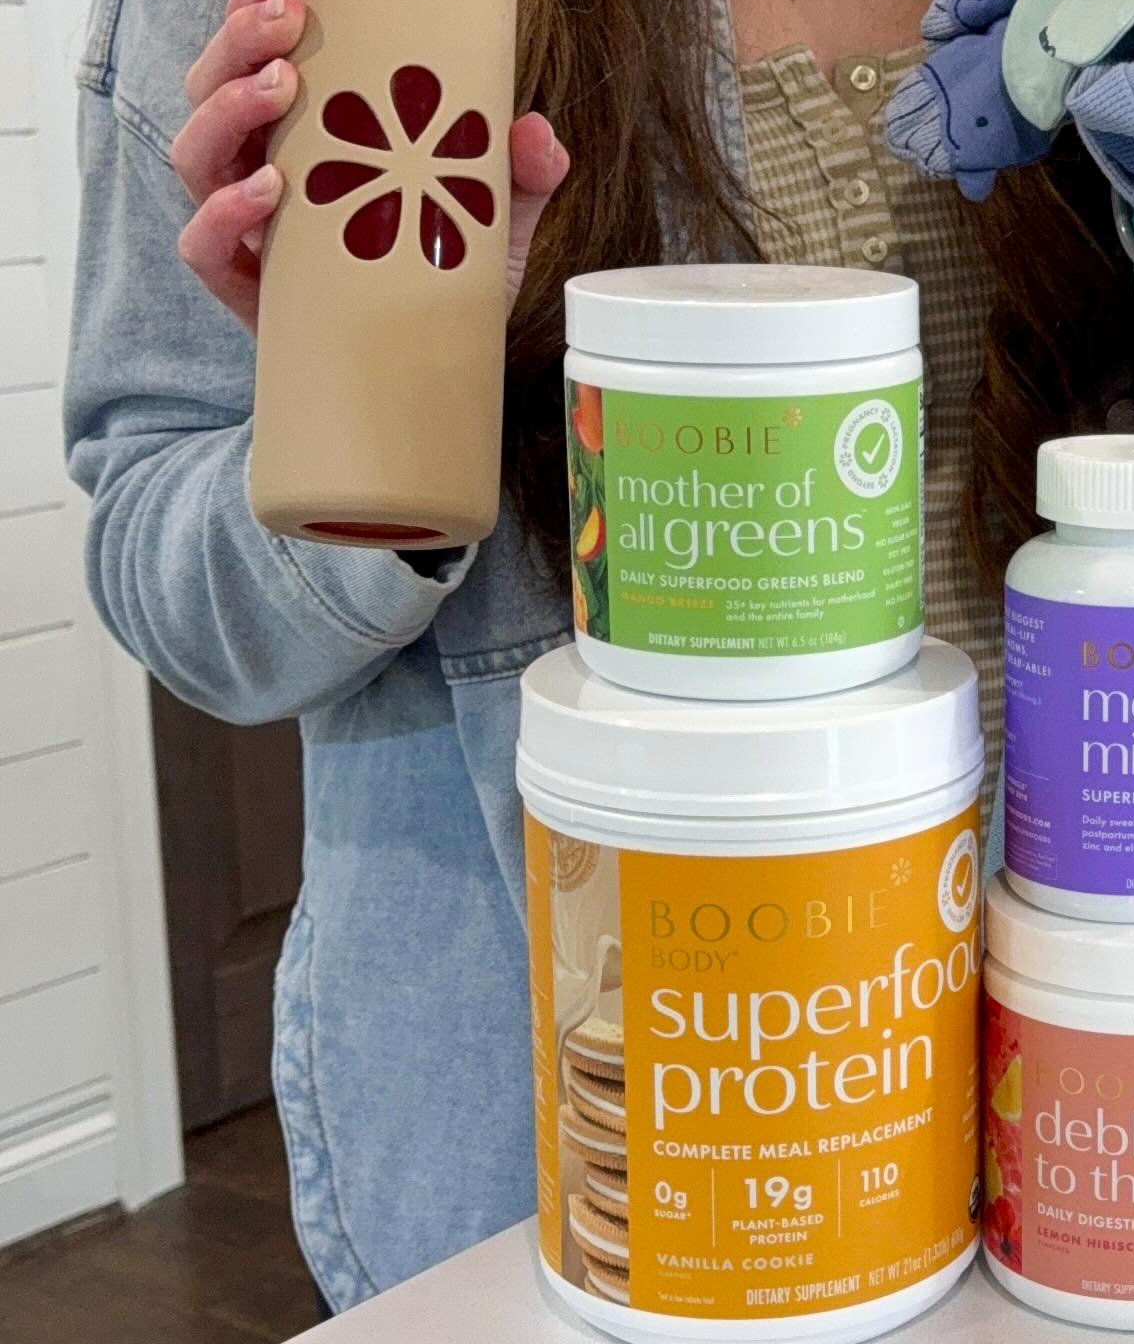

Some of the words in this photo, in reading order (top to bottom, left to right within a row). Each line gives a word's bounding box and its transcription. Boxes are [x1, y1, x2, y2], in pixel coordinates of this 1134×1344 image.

[614, 416, 782, 455] BOOBIE
[618, 469, 764, 510] mother
[775, 467, 817, 506] of
[619, 513, 655, 553] all
[664, 511, 866, 570] greens
[620, 569, 656, 586] DAILY
[659, 574, 753, 591] SUPERFOOD
[757, 574, 818, 591] GREENS
[823, 568, 865, 587] BLEND
[725, 599, 745, 611] 35+
[749, 599, 767, 613] key
[769, 597, 810, 609] nutrients
[812, 597, 826, 608] for
[828, 590, 877, 605] motherhood
[725, 611, 745, 622] and
[748, 611, 763, 622] the
[765, 610, 793, 621] entire
[795, 608, 825, 622] family
[648, 631, 686, 647] DIETARY
[688, 635, 755, 649] SUPPLEMENT
[758, 636, 773, 649] NET
[777, 636, 790, 648] WT
[1082, 814, 1107, 829] Daily
[1081, 840, 1102, 852] zinc
[1103, 841, 1122, 852] and
[650, 888, 889, 944] BOOBIE
[652, 1029, 934, 1131] protein
[652, 1139, 753, 1161] COMPLETE
[759, 1138, 812, 1160] MEAL
[817, 1107, 934, 1154] REPLACEMENT
[1033, 1152, 1076, 1195] to
[654, 1180, 688, 1210] 0g
[743, 1176, 813, 1211] 19g
[860, 1162, 899, 1193] 110
[859, 1188, 900, 1208] CALORIES
[731, 1213, 824, 1232] PLANT-BASED
[1037, 1202, 1074, 1223] DAILY
[749, 1231, 808, 1246] PROTEIN
[1037, 1225, 1081, 1246] LEMON
[656, 1252, 735, 1272] VANILLA
[741, 1252, 815, 1272] COOKIE
[746, 1288, 791, 1307] DIETARY
[795, 1274, 861, 1303] SUPPLEMENT
[869, 1265, 885, 1288] NET
[887, 1262, 901, 1282] WT
[1081, 1279, 1111, 1294] DIETARY
